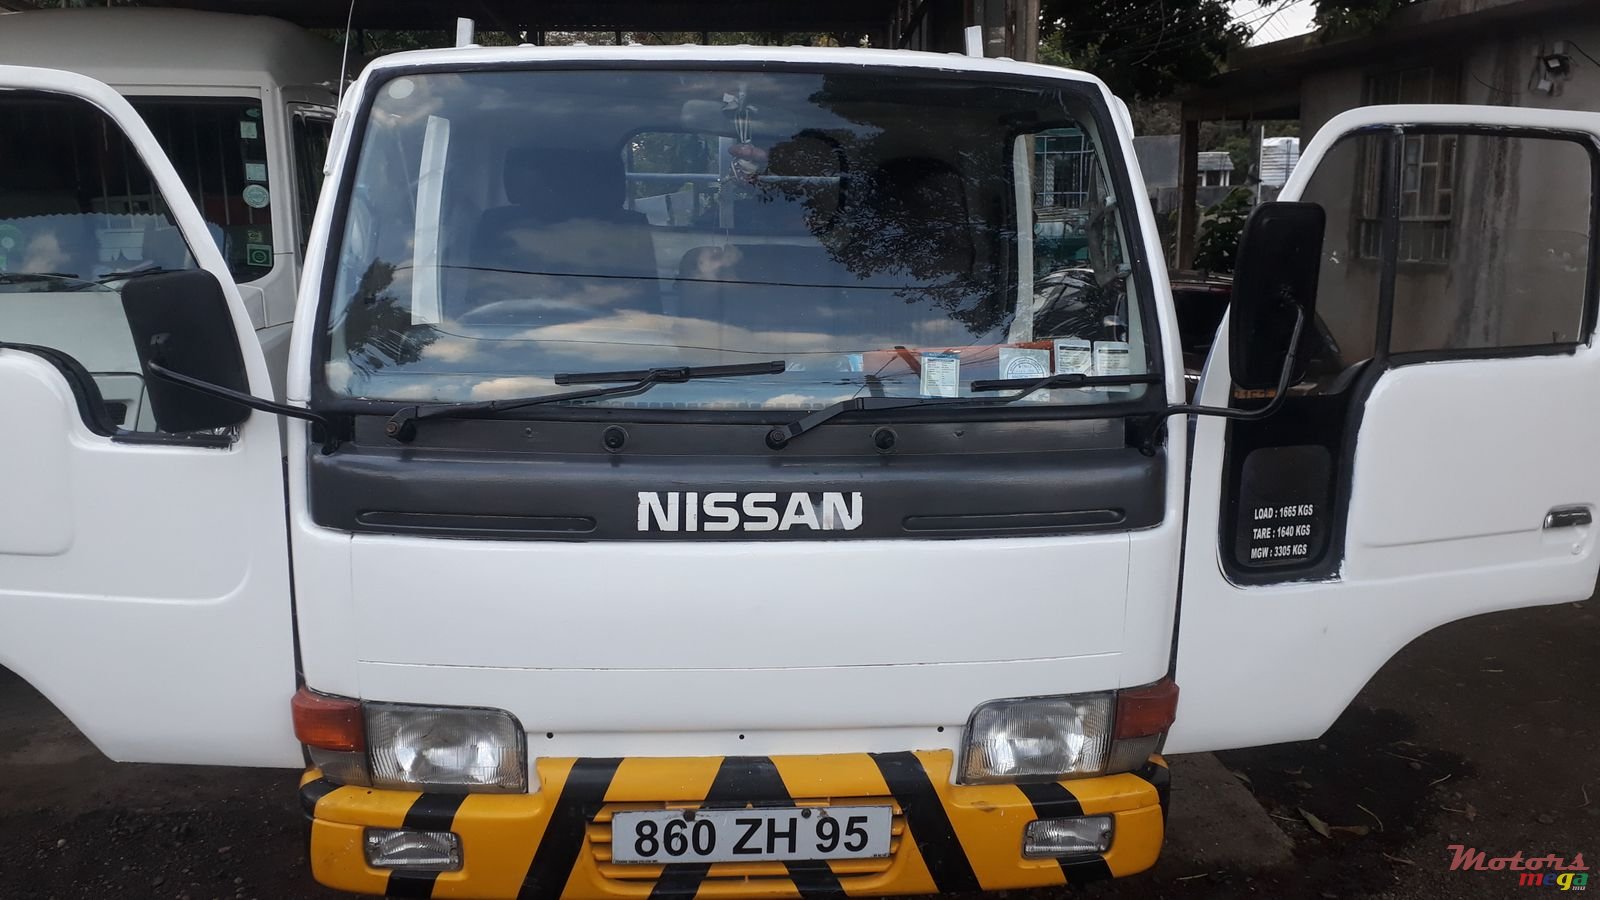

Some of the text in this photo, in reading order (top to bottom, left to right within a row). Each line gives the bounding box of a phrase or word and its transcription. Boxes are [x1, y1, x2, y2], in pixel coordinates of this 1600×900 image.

[637, 491, 863, 532] NISSAN
[1254, 508, 1274, 520] LOAD
[1280, 506, 1297, 518] 1665
[1298, 504, 1313, 516] KGS
[1253, 528, 1271, 539] TARE
[1277, 526, 1294, 537] 1640
[1295, 524, 1310, 536] KGS
[1251, 547, 1269, 559] MGW
[1274, 545, 1291, 556] 3305
[1292, 544, 1307, 555] KGS
[633, 815, 869, 858] 860 ZH 95
